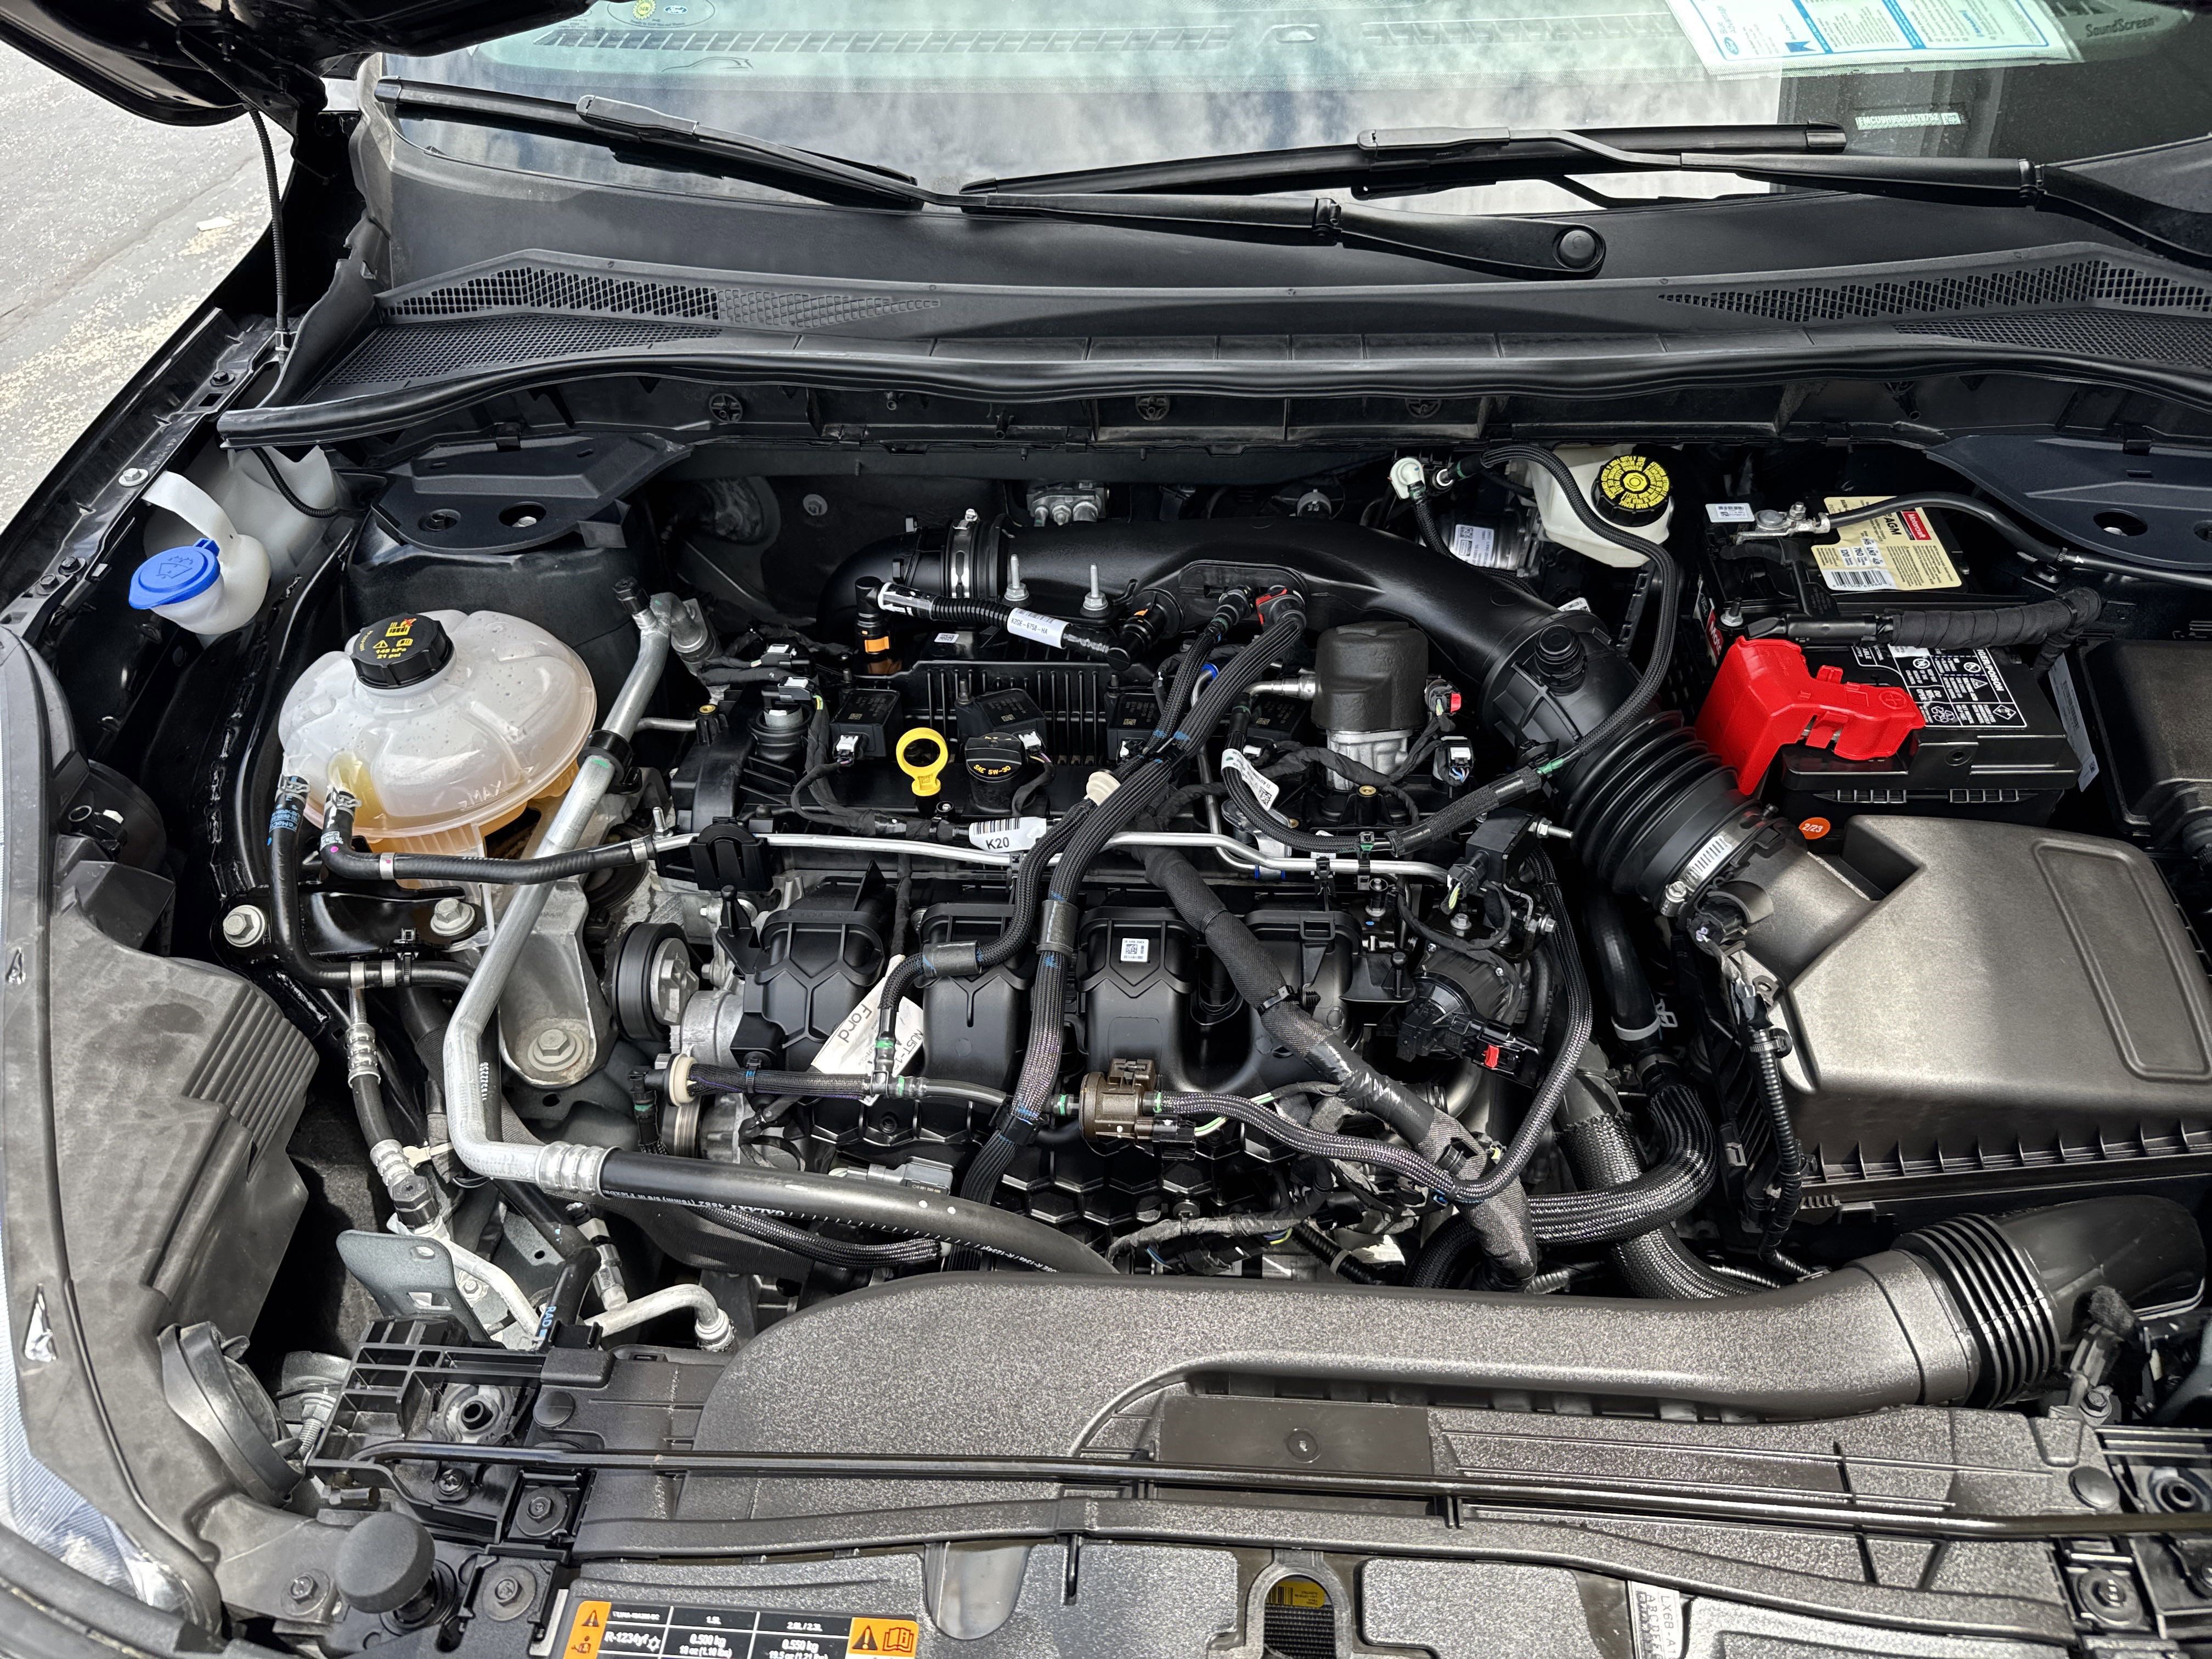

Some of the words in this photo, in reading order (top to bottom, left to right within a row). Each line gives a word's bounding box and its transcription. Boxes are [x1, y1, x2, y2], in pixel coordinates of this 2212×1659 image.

[2085, 17, 2154, 37] SoundScreen
[1883, 516, 1902, 535] AGM
[1907, 512, 1926, 539] Motorcraft
[1841, 549, 1850, 557] 120
[1853, 548, 1864, 556] 760
[1867, 548, 1877, 556] LN3
[1925, 690, 1936, 698] NOT
[973, 764, 986, 774] SAE
[988, 765, 1012, 775] 5W-30
[467, 780, 503, 805] MAX
[1802, 823, 1824, 833] 2/23
[985, 837, 1010, 850] K20
[837, 1003, 872, 1043] Ford
[731, 1204, 785, 1216] GALAXY
[542, 1306, 557, 1327] RAD
[604, 1630, 650, 1646] R-1234yf
[689, 1633, 713, 1646] 0.500
[713, 1635, 726, 1648] kg
[782, 1638, 806, 1651] 0.550
[806, 1640, 819, 1653] kg
